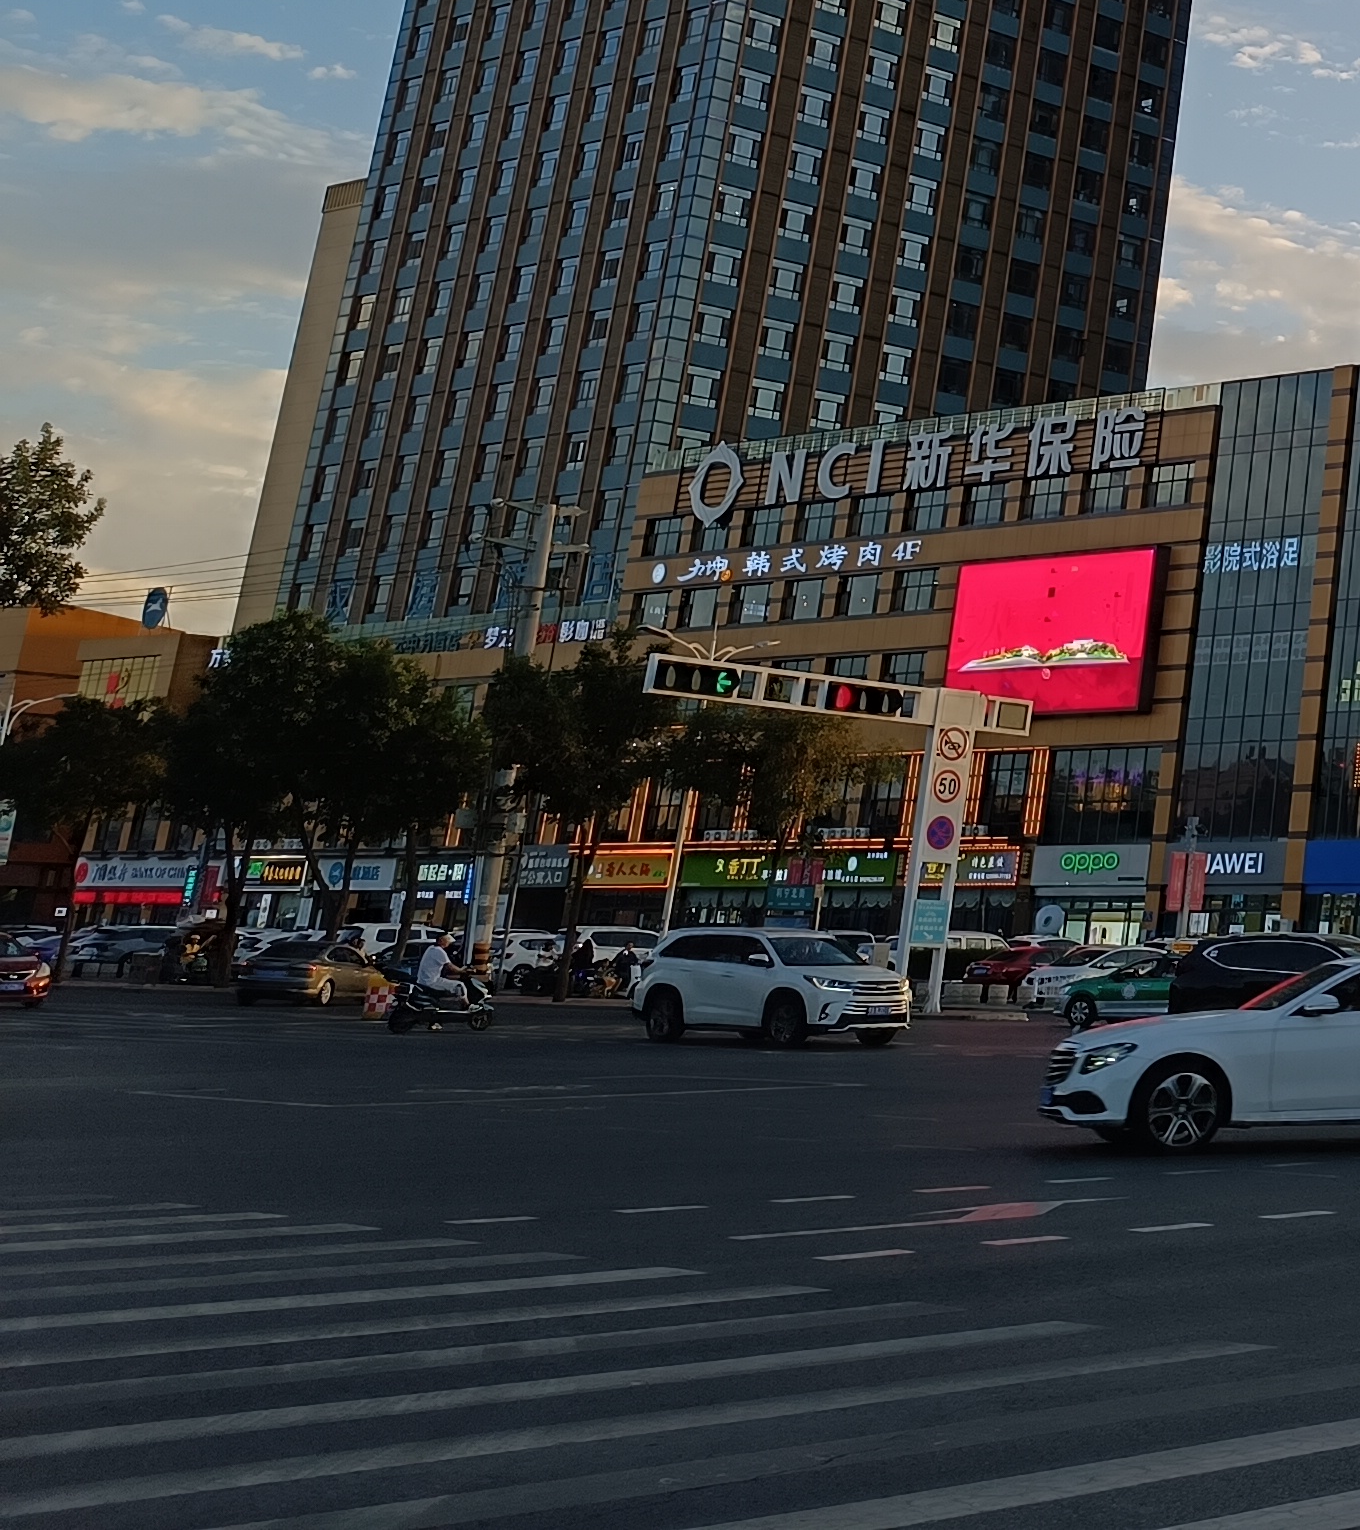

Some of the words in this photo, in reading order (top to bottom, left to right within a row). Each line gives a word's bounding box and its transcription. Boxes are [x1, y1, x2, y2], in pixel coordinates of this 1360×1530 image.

[764, 439, 885, 506] NCI
[902, 406, 1147, 492] 新华保险
[742, 542, 882, 577] 韩式烤肉
[891, 540, 922, 562] 4F
[1203, 537, 1299, 574] 影院式浴足
[938, 777, 957, 795] 50
